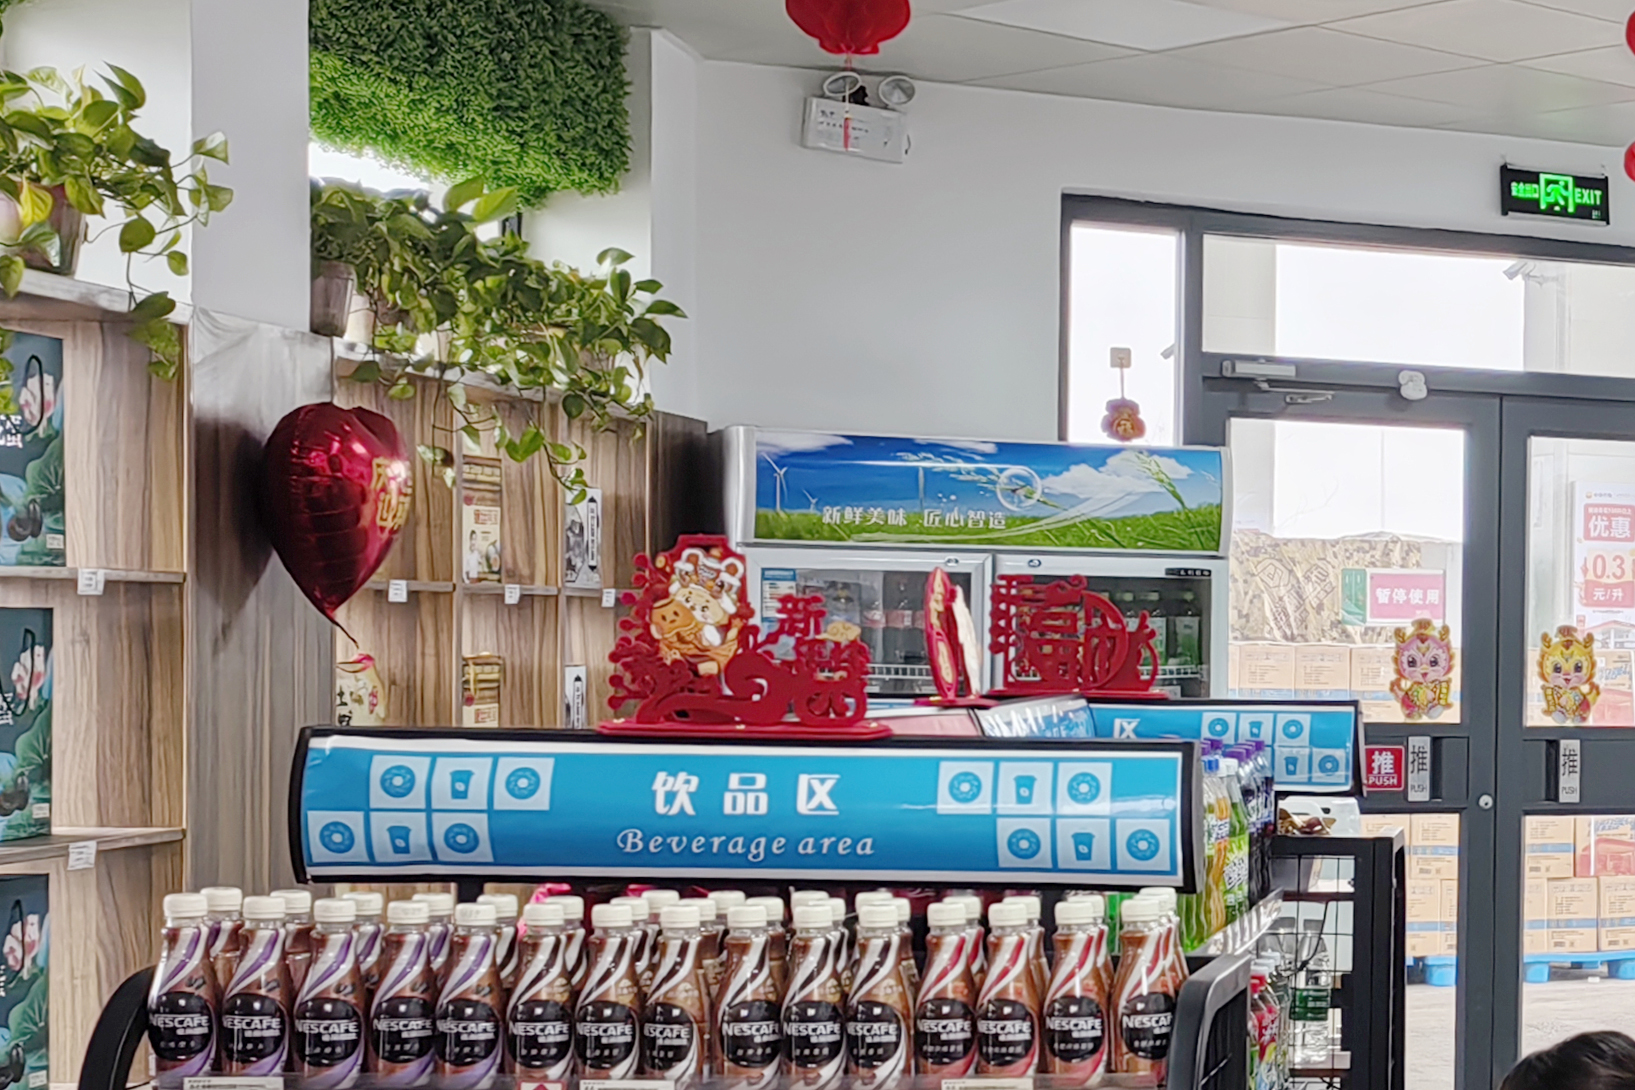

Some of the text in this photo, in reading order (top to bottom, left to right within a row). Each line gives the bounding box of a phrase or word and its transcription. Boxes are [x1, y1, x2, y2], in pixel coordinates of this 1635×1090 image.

[1574, 187, 1602, 205] EXIT
[822, 505, 1007, 530] 新鲜美味 匠心智造
[1588, 515, 1632, 539] 优惠
[1592, 554, 1626, 580] 0.3
[1376, 587, 1440, 605] 暂停使用
[1592, 588, 1624, 602] 元/升
[1371, 750, 1395, 775] 推
[1410, 745, 1428, 774] 推
[1562, 747, 1578, 776] 推
[1368, 775, 1398, 786] PUSH
[1410, 784, 1427, 793] PUSH
[1562, 786, 1577, 795] PUSH
[651, 770, 841, 816] 饮品区
[616, 828, 875, 862] Beverage area
